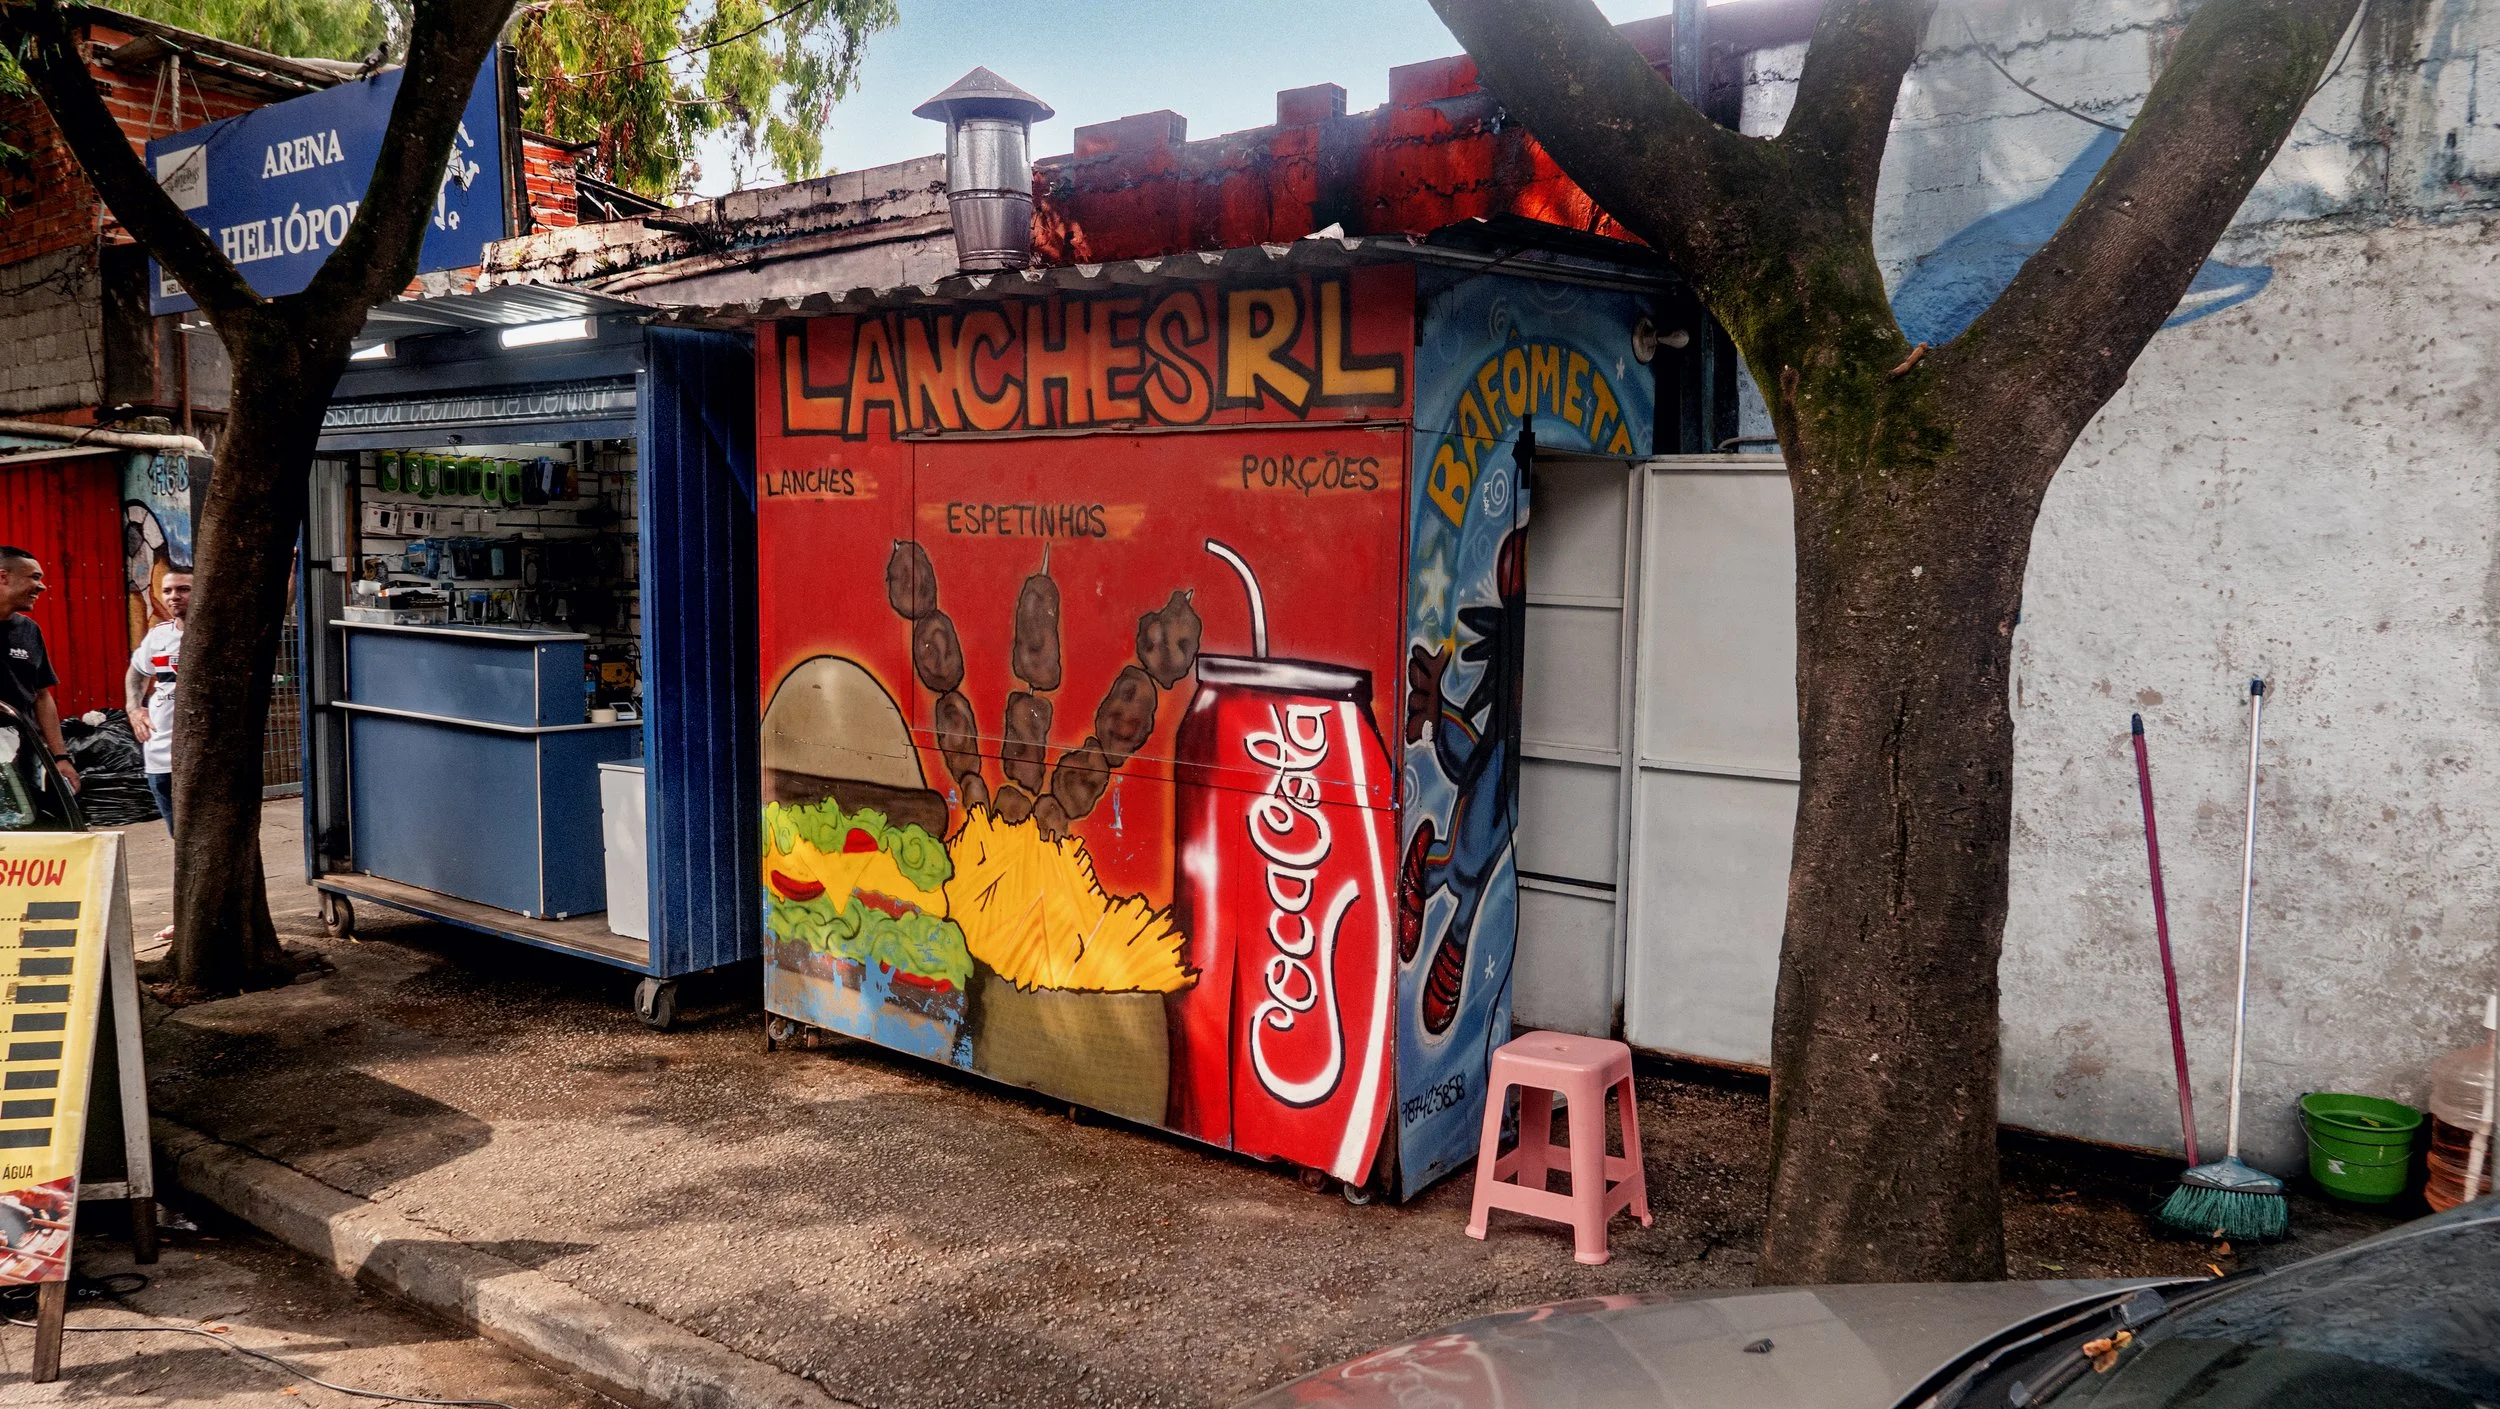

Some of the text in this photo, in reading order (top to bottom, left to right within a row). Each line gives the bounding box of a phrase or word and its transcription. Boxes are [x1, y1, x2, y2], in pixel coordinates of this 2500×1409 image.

[262, 129, 344, 179] ARENA
[779, 278, 1407, 442] LANCHES RL
[766, 469, 855, 497] LANCHES
[1242, 449, 1380, 497] PORÇÕES
[948, 502, 1107, 538] ESPETINHOS
[2, 1163, 33, 1180] ÁGUA
